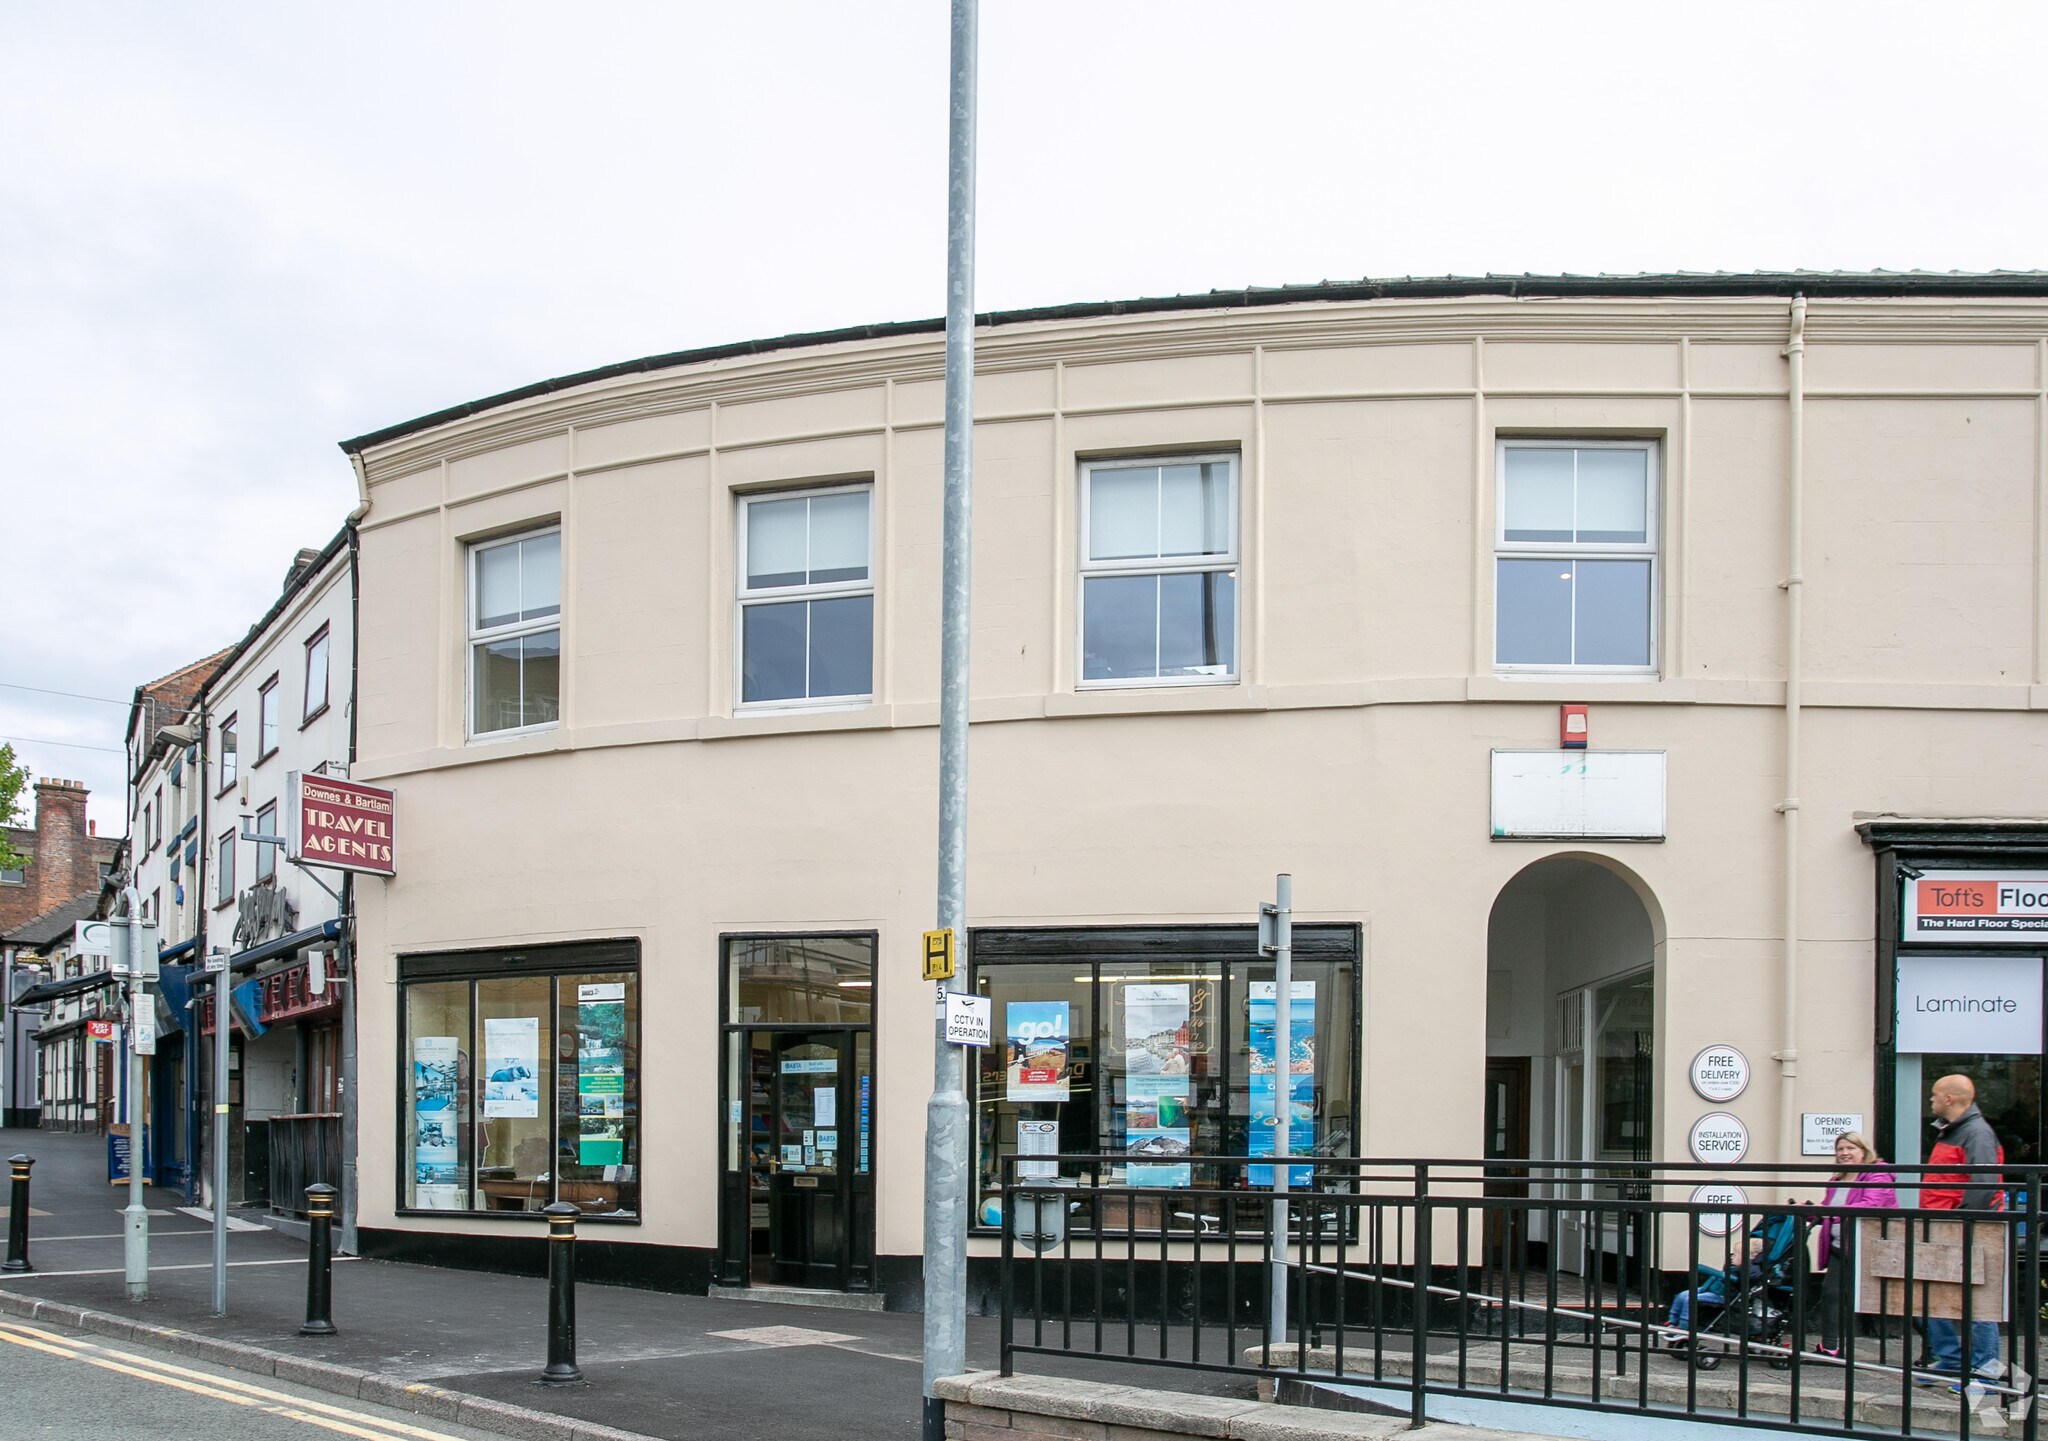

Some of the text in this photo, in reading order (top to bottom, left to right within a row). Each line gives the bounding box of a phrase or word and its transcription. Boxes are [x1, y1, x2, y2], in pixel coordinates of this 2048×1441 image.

[304, 786, 390, 812] Downes & Bartlam
[304, 808, 391, 839] TRAVEL
[304, 833, 391, 862] AGENTS
[1922, 919, 1944, 928] The
[1946, 919, 1976, 928] Hard
[1978, 919, 2009, 928] Floor
[1916, 995, 2017, 1013] Laminate
[954, 1014, 983, 1027] CCTV IN
[948, 1025, 988, 1039] OPERATION
[1018, 1014, 1063, 1046] go!
[1708, 1055, 1734, 1067] FREE
[1700, 1070, 1741, 1080] DELIVERY
[1814, 1117, 1852, 1126] OPENING
[1698, 1131, 1742, 1139] INSTALLATION
[1822, 1127, 1846, 1136] TIMES
[1698, 1139, 1742, 1151] SERVICE
